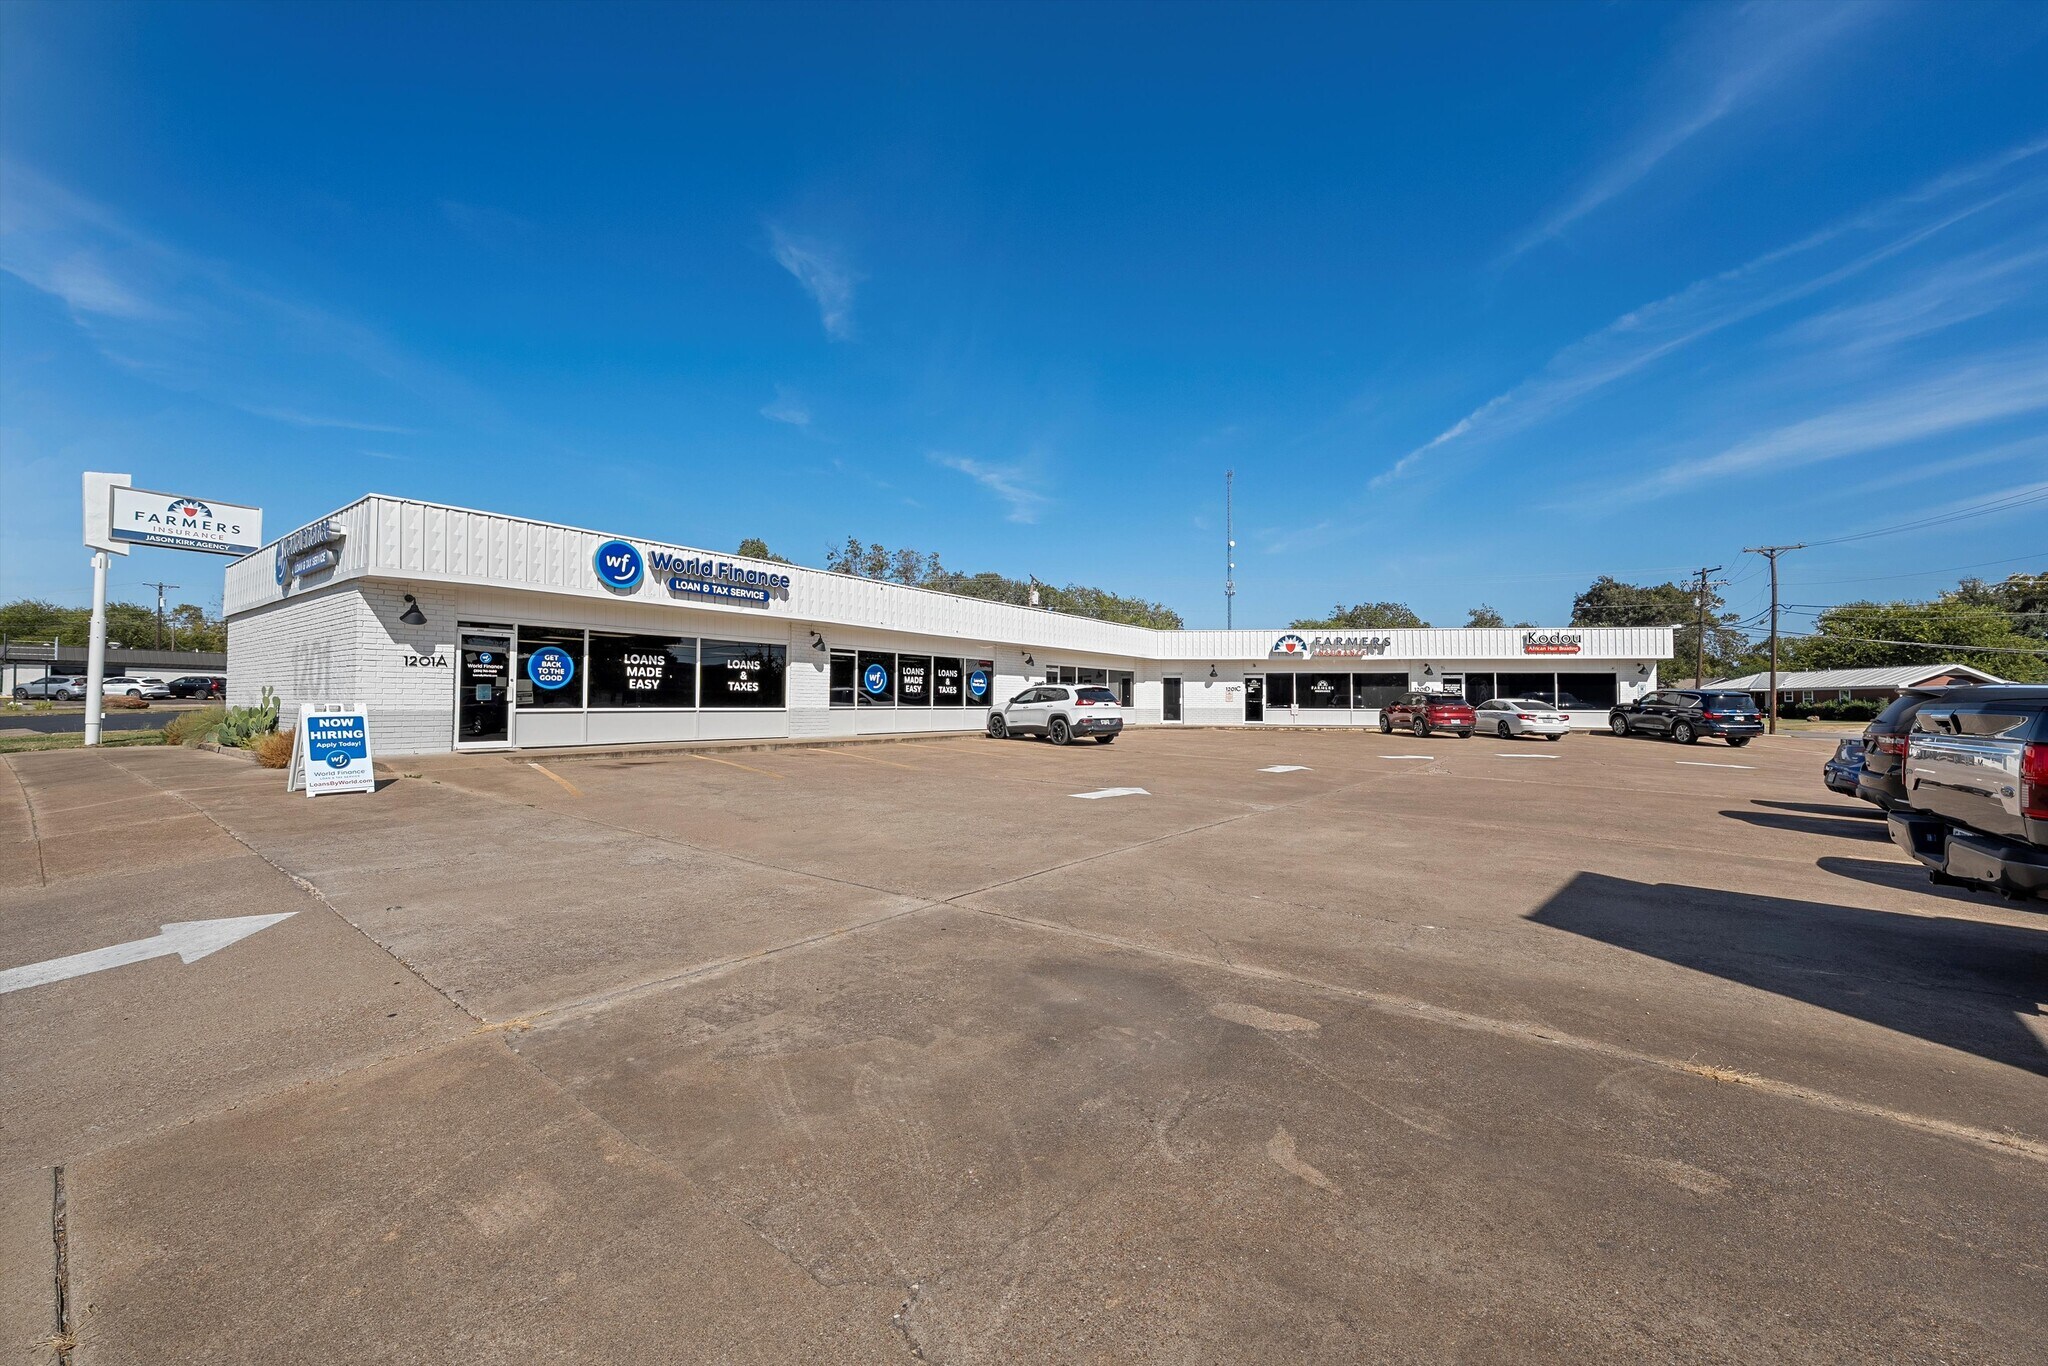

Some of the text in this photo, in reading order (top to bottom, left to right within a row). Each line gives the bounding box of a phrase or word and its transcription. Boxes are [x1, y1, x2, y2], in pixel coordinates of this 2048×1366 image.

[135, 511, 241, 534] FARMERS
[153, 526, 224, 541] INSURANCE
[145, 534, 230, 551] JASON KIRK AGENCY
[650, 551, 790, 588] World Finance
[675, 580, 765, 600] LOAN & TAX SERVICE
[1315, 637, 1391, 646] FARMERS
[1528, 632, 1581, 644] Kodou
[404, 655, 448, 667] 1201A
[624, 654, 665, 666] LOANS
[727, 659, 760, 670] LOANS
[627, 666, 662, 677] MADE
[740, 671, 747, 680] &
[902, 667, 924, 676] LOANS
[938, 669, 958, 677] LOANS
[629, 679, 660, 690] EASY
[904, 676, 923, 684] MADE
[728, 682, 759, 691] TAXES
[905, 685, 922, 693] EASY
[938, 686, 957, 694] TAXES
[319, 718, 354, 727] NOW
[310, 730, 364, 740] HIRING
[309, 779, 373, 787] LoansByWorld.com
